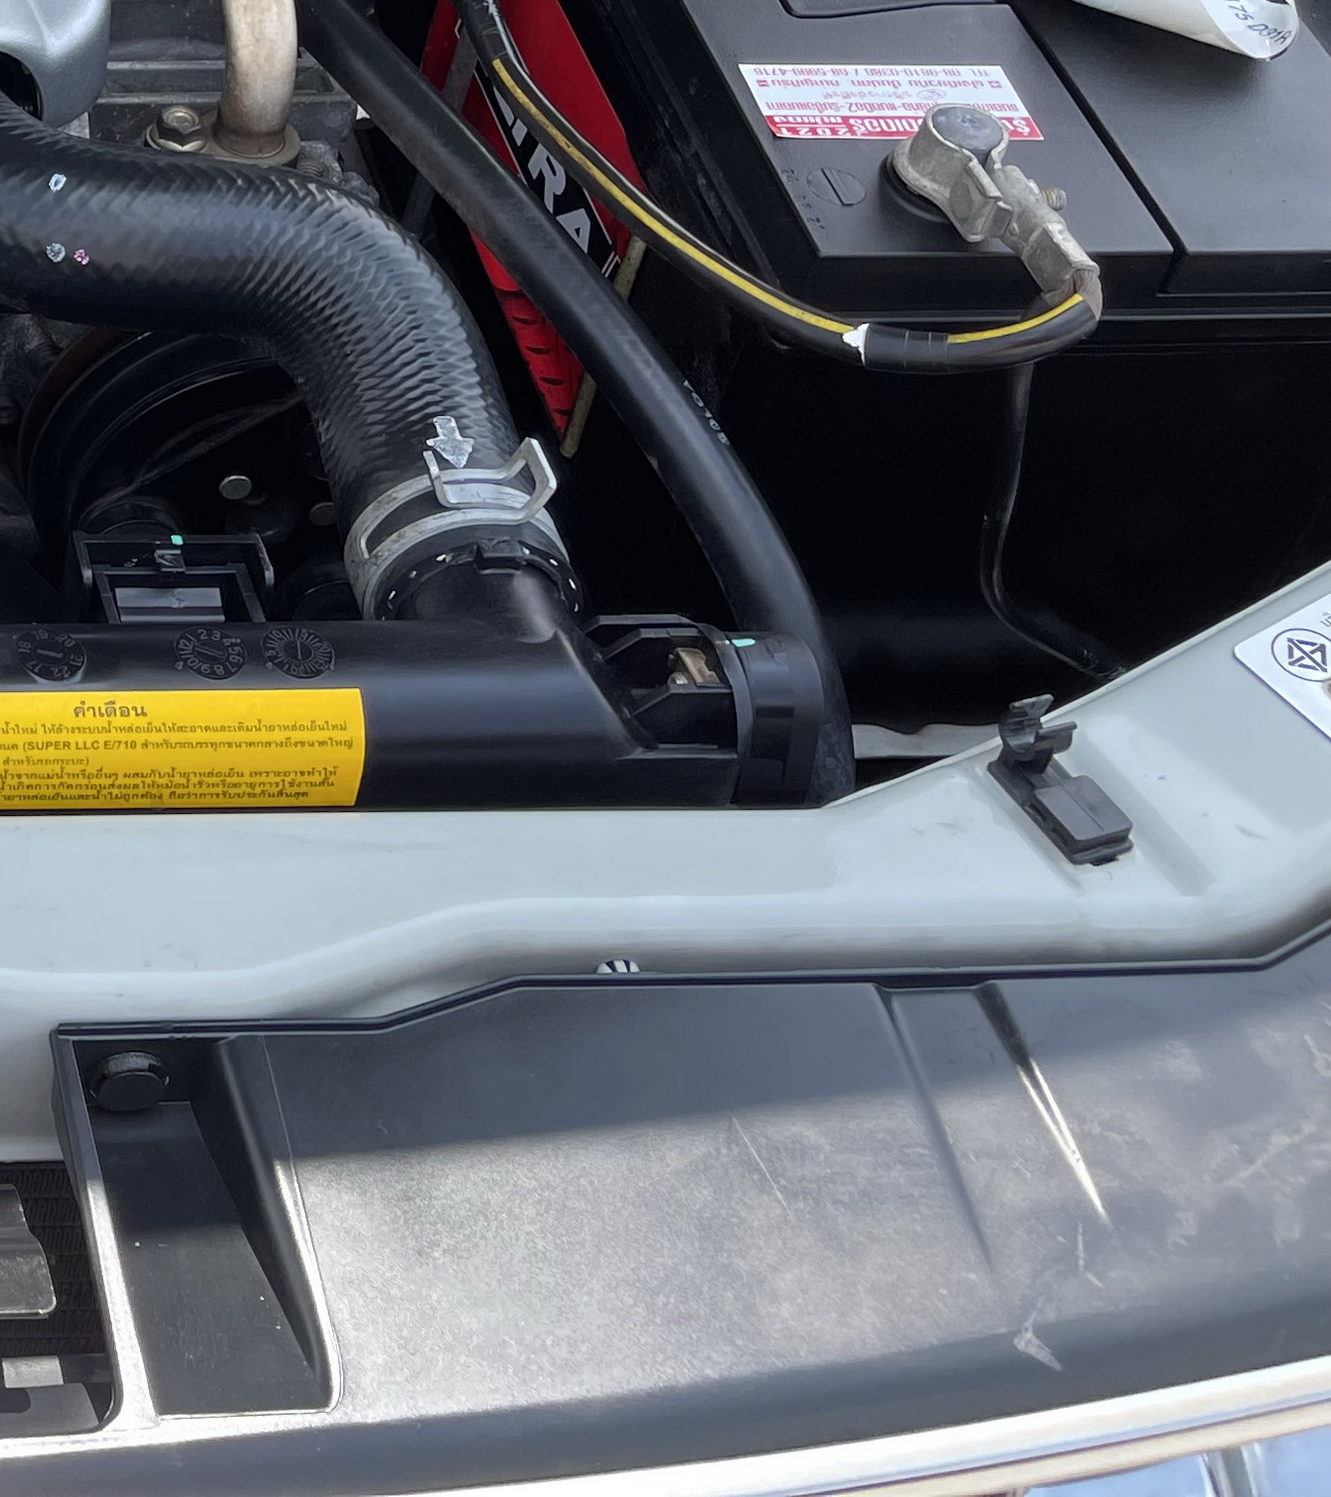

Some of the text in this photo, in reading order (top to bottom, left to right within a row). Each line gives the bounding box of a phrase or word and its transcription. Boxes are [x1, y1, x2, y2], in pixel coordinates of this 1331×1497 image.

[72, 700, 148, 719] คำเตือน
[22, 739, 71, 753] (SUPER
[74, 740, 100, 751] LLC
[102, 739, 137, 751] E/710
